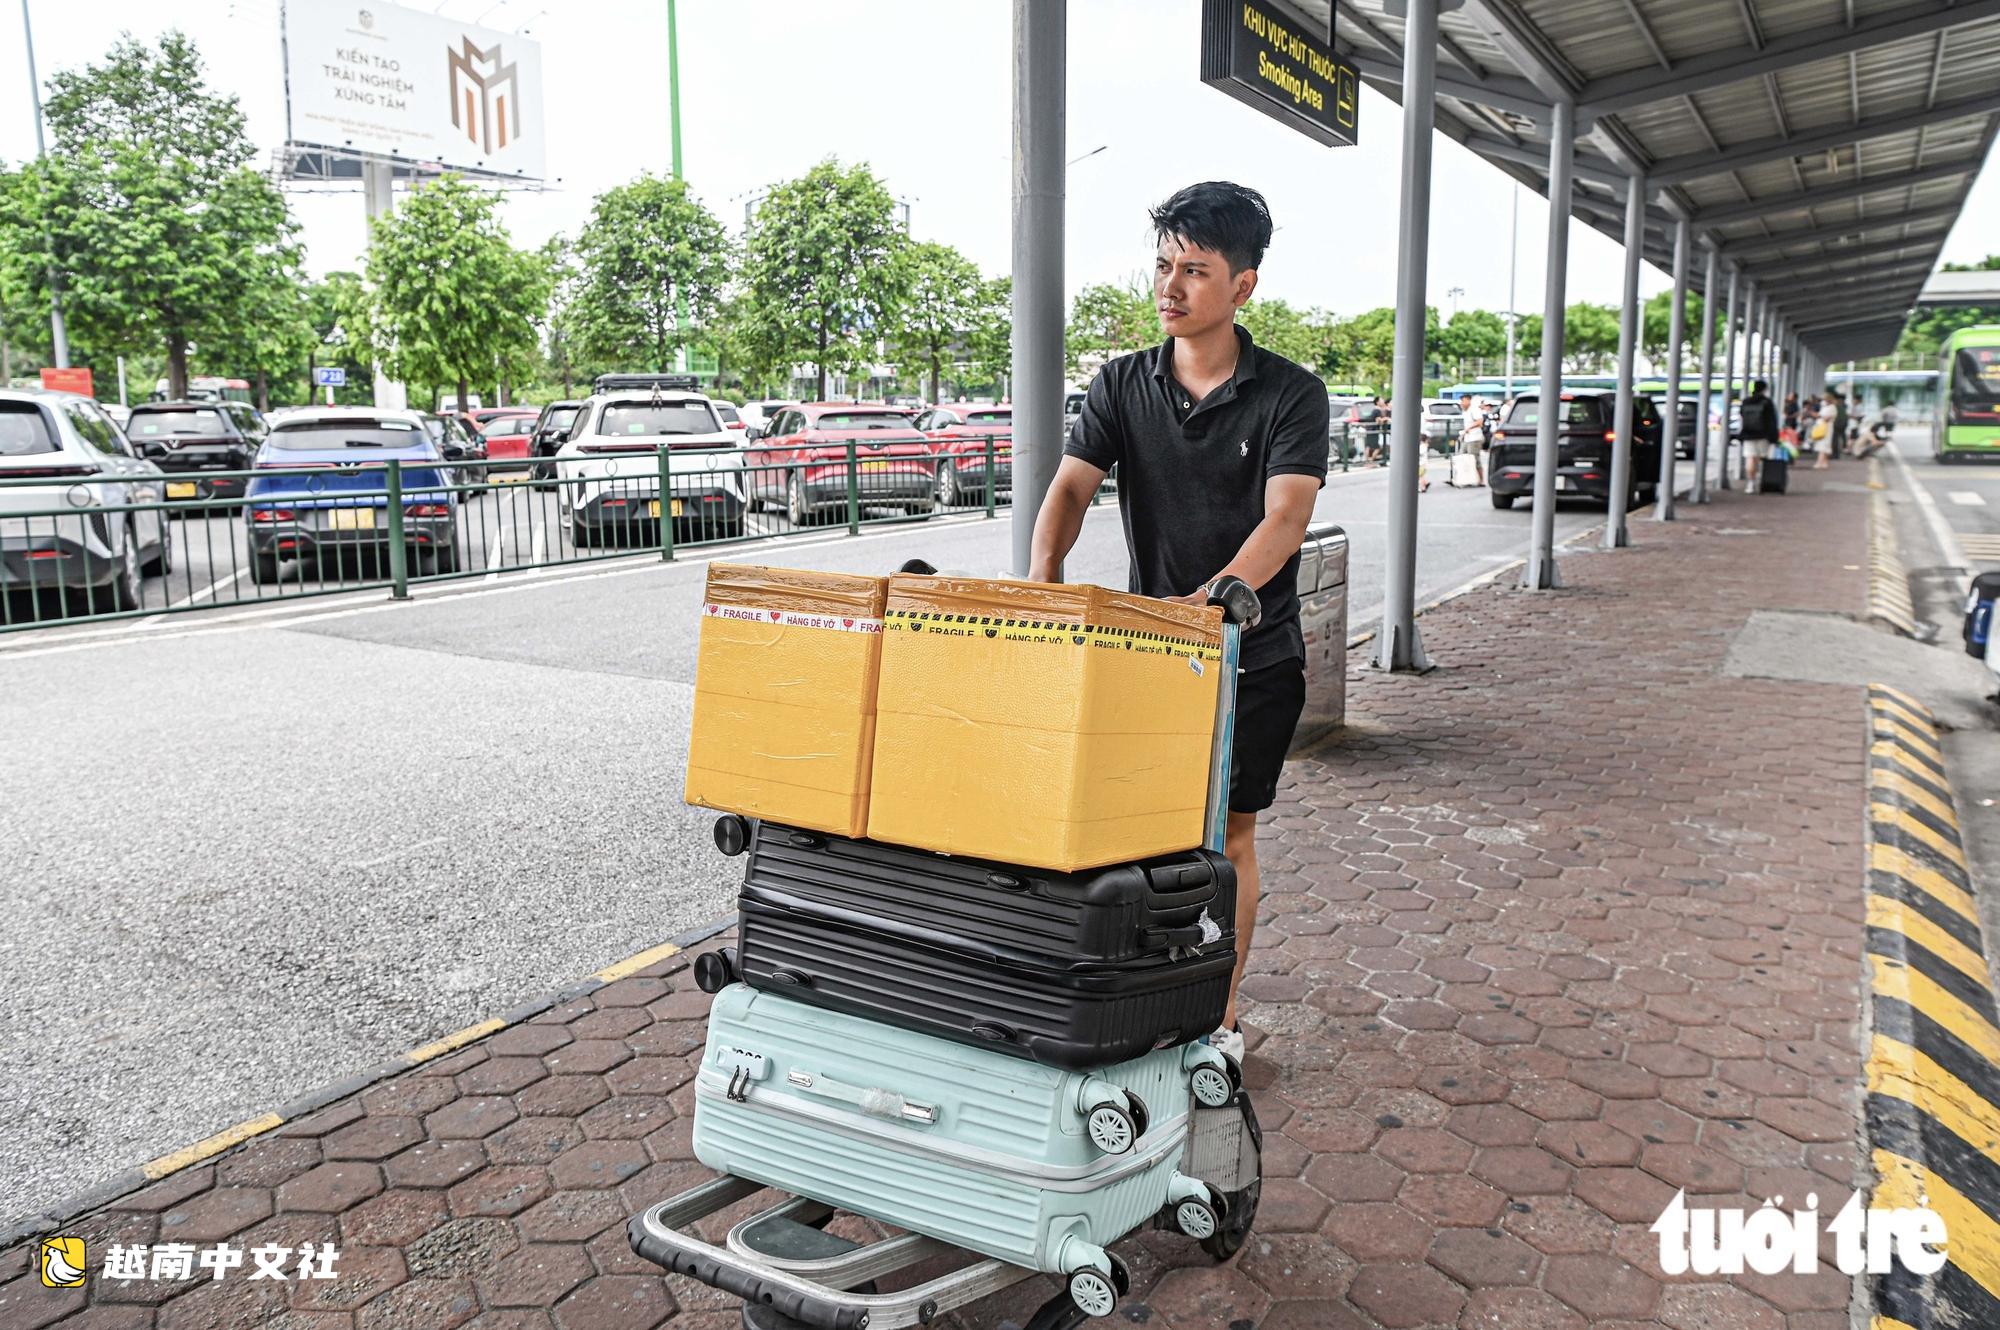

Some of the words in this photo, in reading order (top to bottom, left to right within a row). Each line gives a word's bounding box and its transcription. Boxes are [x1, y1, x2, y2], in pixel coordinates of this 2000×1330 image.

[1243, 3, 1265, 38] KHU
[1267, 19, 1288, 52] VỰC
[1288, 34, 1307, 65] HÚT
[1307, 48, 1336, 84] THUỐC
[1258, 50, 1301, 104] Smoking
[1301, 79, 1323, 111] Area
[723, 608, 762, 621] FRAGILE
[786, 615, 809, 626] HÀNG
[860, 622, 884, 633] FRA
